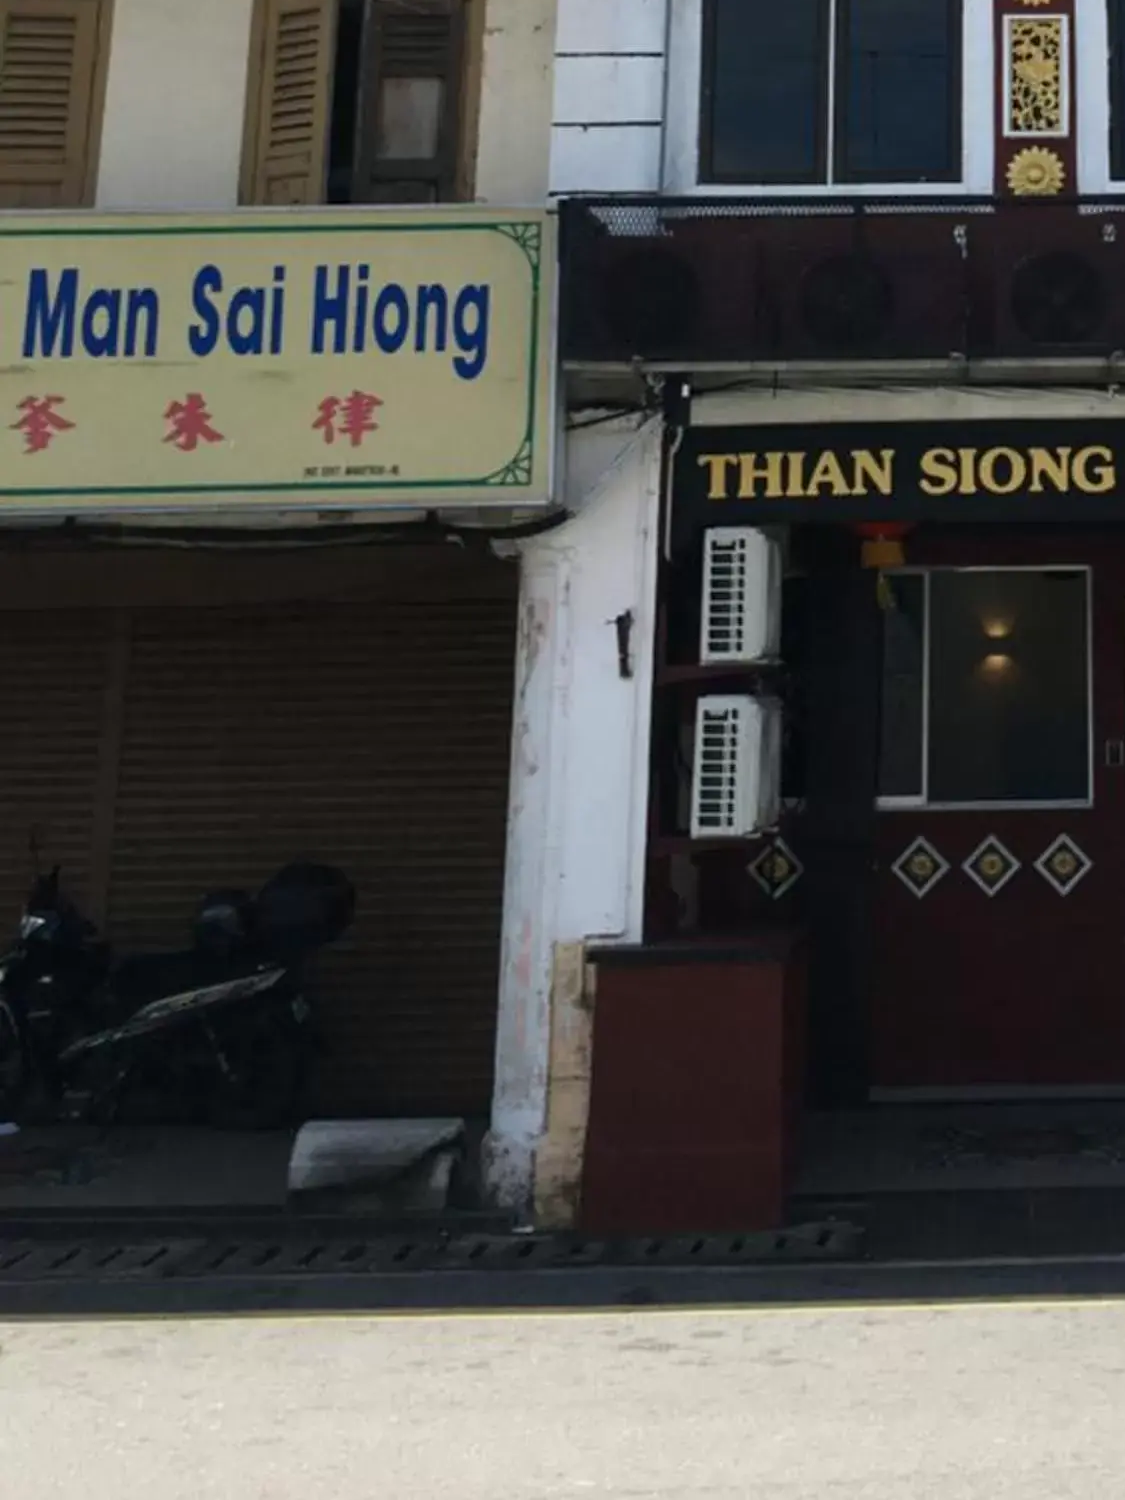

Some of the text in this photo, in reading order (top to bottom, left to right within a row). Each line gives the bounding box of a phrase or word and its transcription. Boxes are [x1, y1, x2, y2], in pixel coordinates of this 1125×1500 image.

[22, 264, 490, 379] Man Sai Hiong
[699, 449, 895, 499] THIAN
[918, 445, 1116, 495] SIONG
